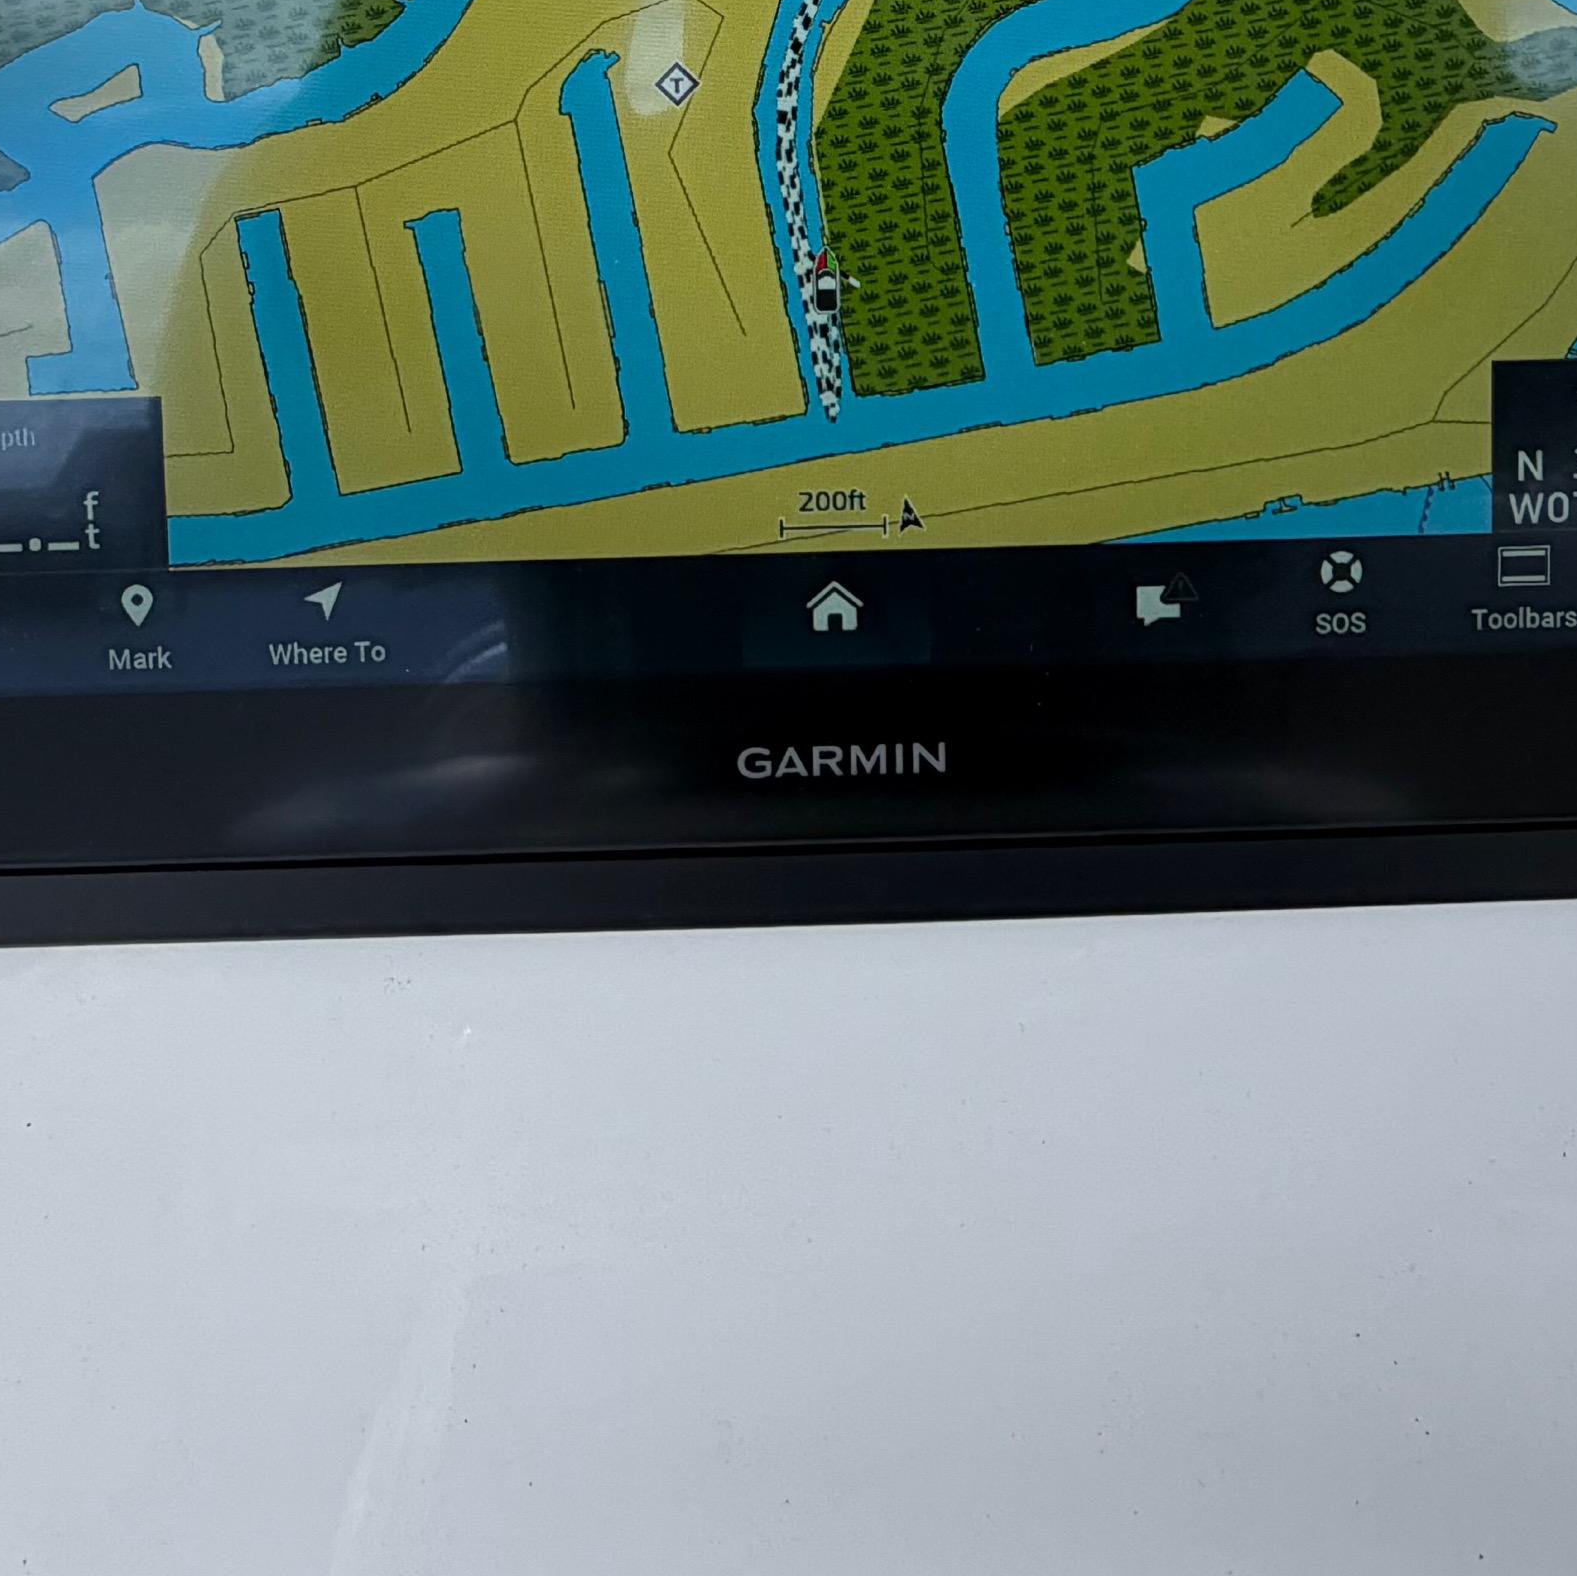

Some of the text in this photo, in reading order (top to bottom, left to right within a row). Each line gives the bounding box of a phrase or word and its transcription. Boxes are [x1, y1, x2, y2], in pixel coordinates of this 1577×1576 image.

[1517, 449, 1545, 482] N
[797, 489, 867, 513] 200ft
[1316, 611, 1367, 635] SOS
[108, 646, 173, 671] Mark
[268, 640, 387, 666] Where To
[736, 741, 947, 780] GARMIN
